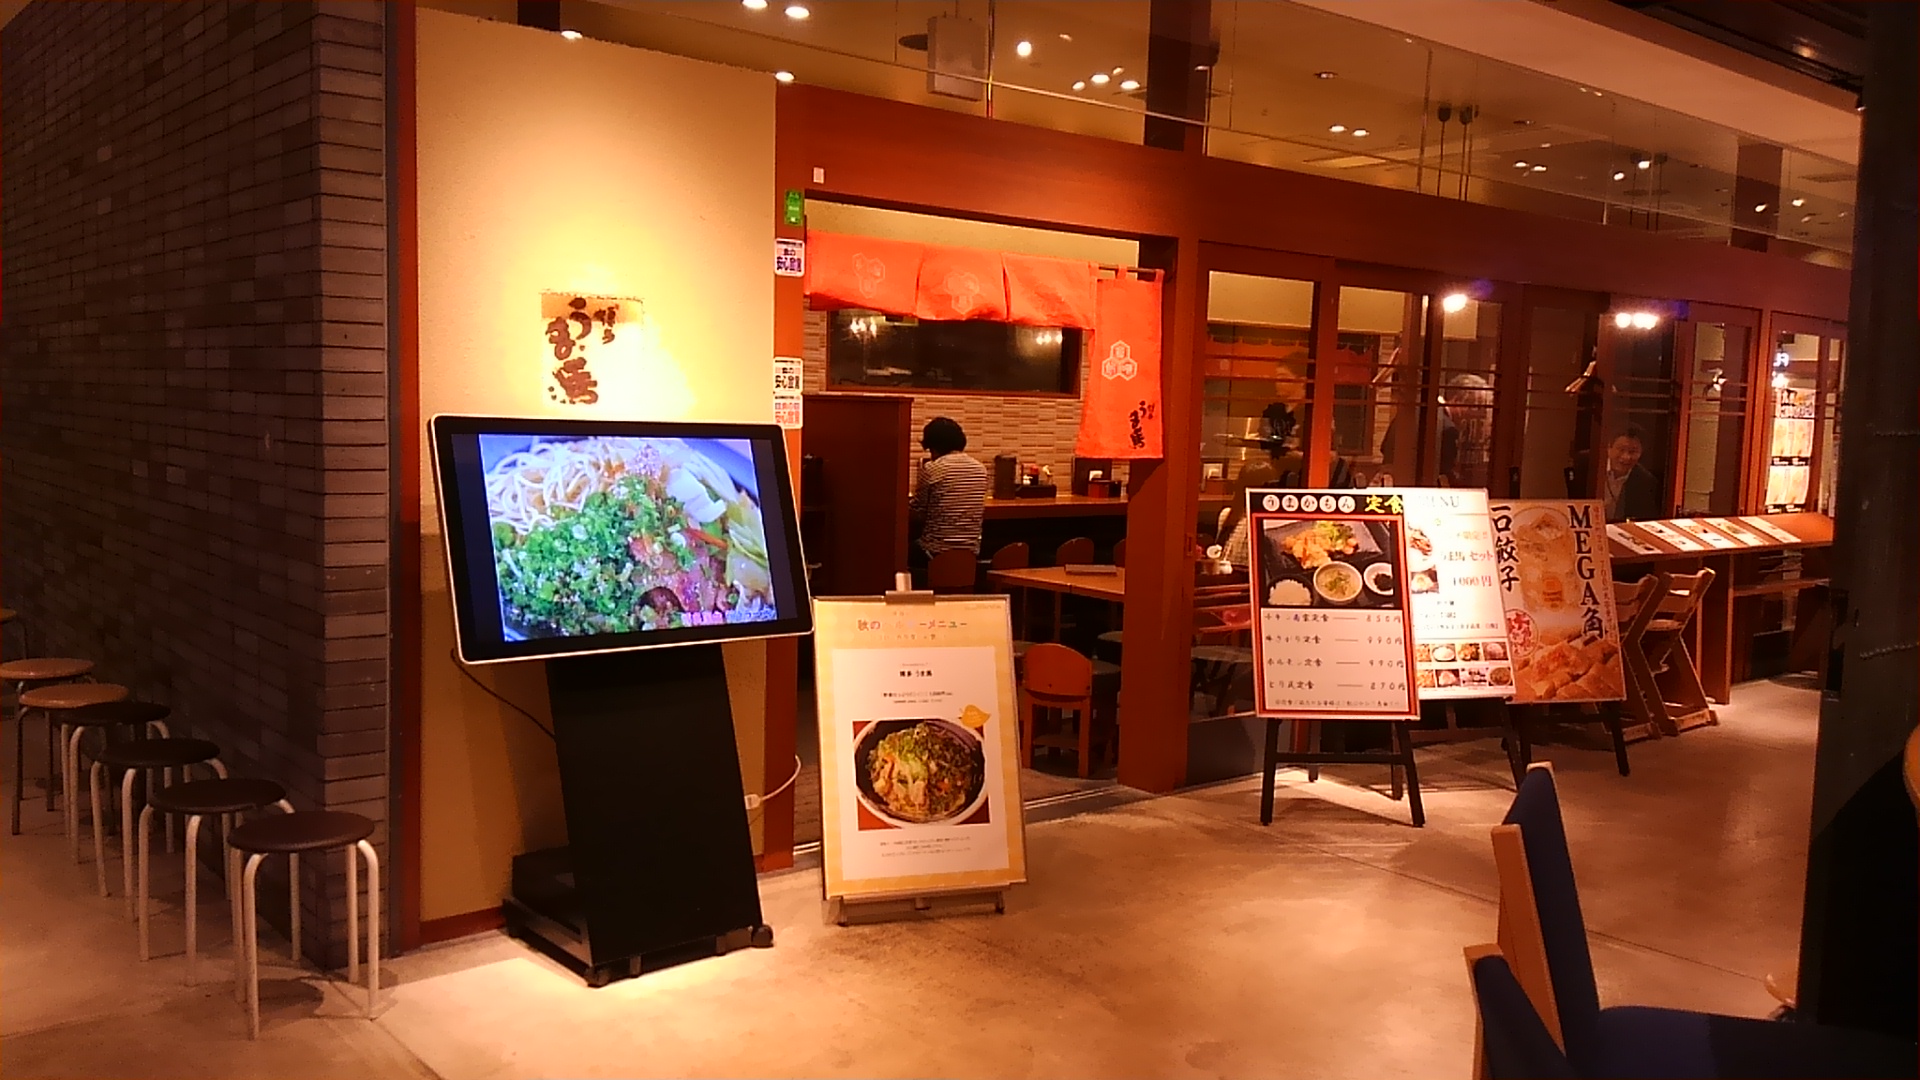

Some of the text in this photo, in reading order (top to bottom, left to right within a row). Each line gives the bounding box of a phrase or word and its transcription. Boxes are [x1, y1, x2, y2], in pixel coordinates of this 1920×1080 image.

[1263, 494, 1404, 515] うまかもん 定食
[1469, 549, 1495, 561] セット
[1491, 505, 1520, 592] 一口餃子
